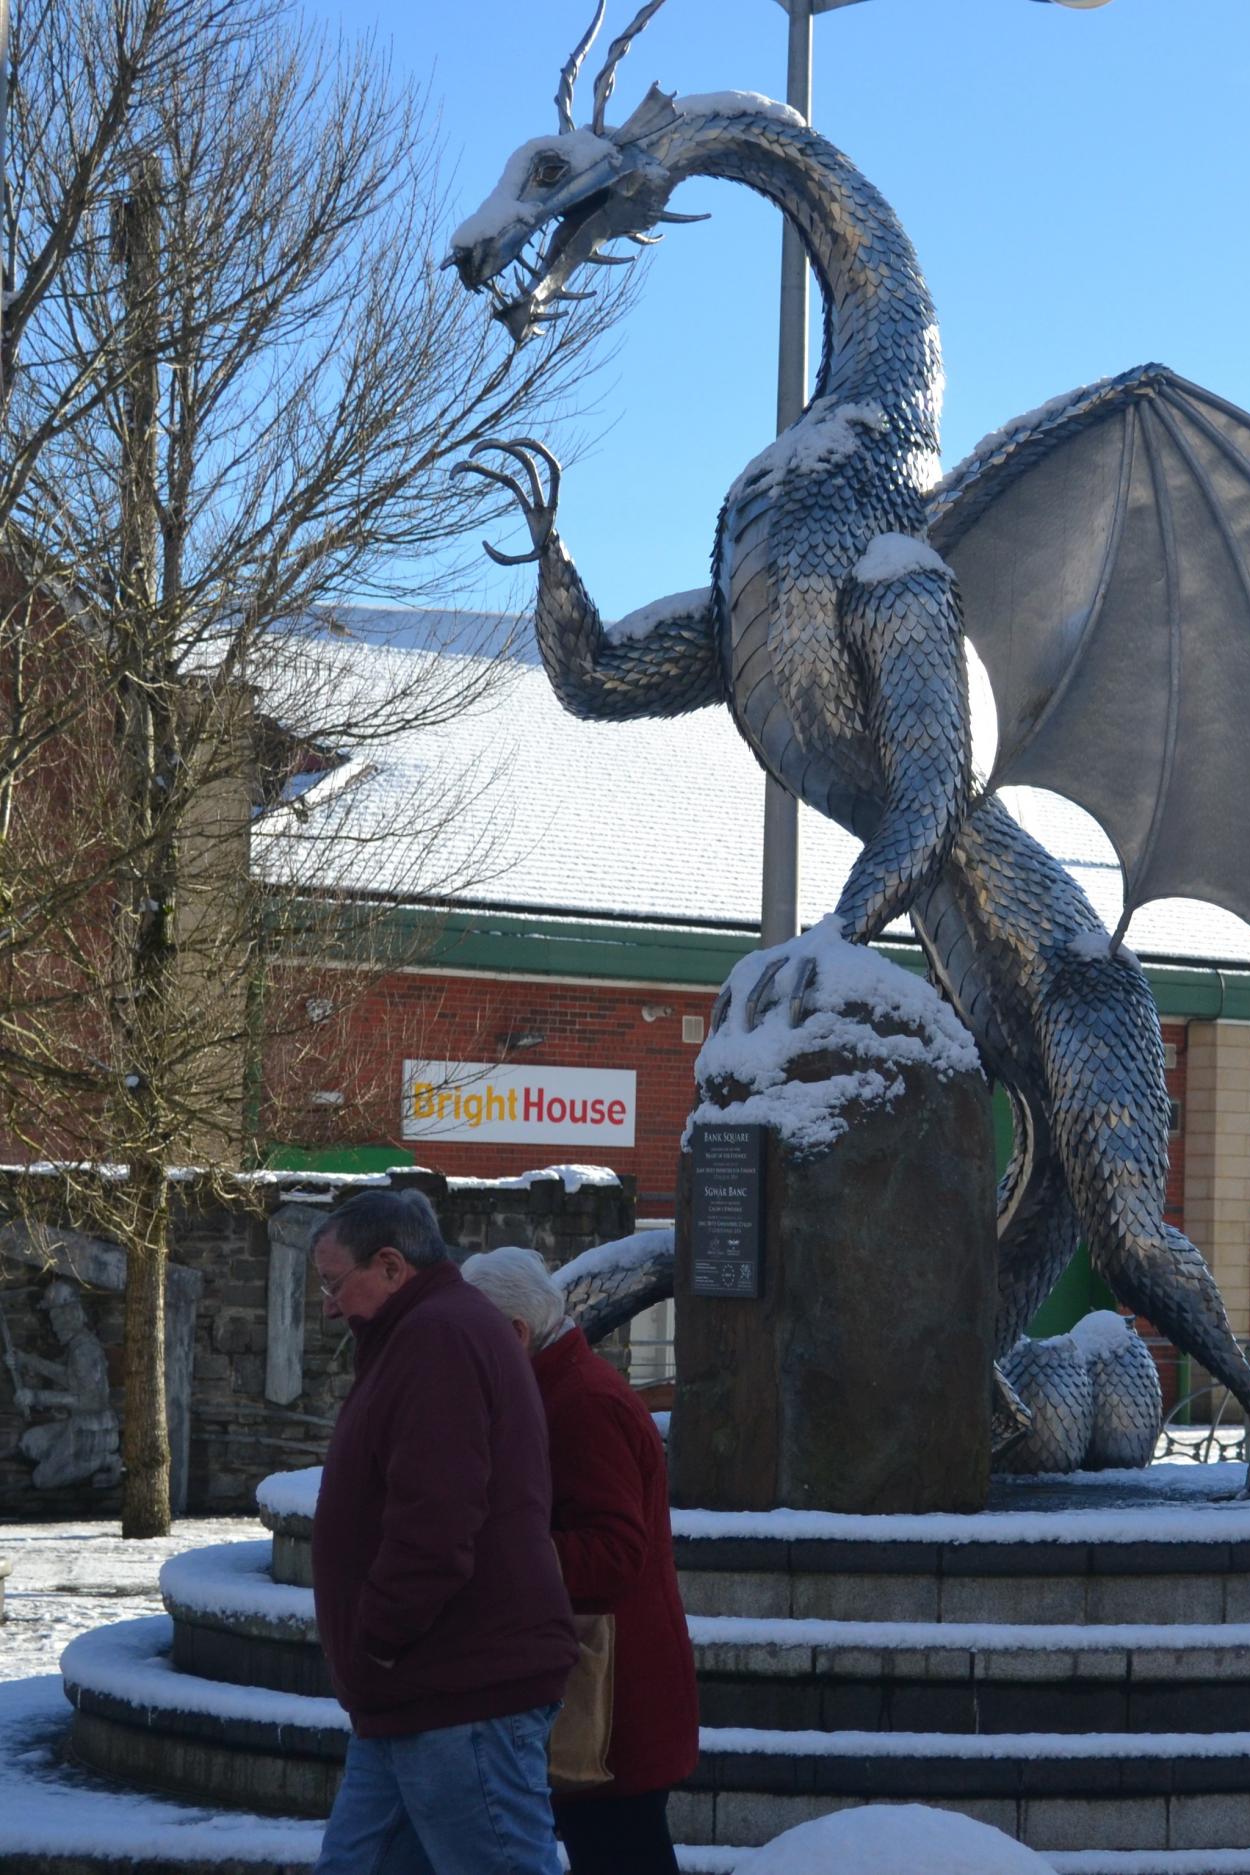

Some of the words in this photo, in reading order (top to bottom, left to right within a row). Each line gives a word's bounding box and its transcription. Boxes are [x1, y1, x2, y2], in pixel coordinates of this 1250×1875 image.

[704, 1132, 722, 1142] BANK
[723, 1131, 749, 1144] SQUARE
[728, 1186, 748, 1197] BANC
